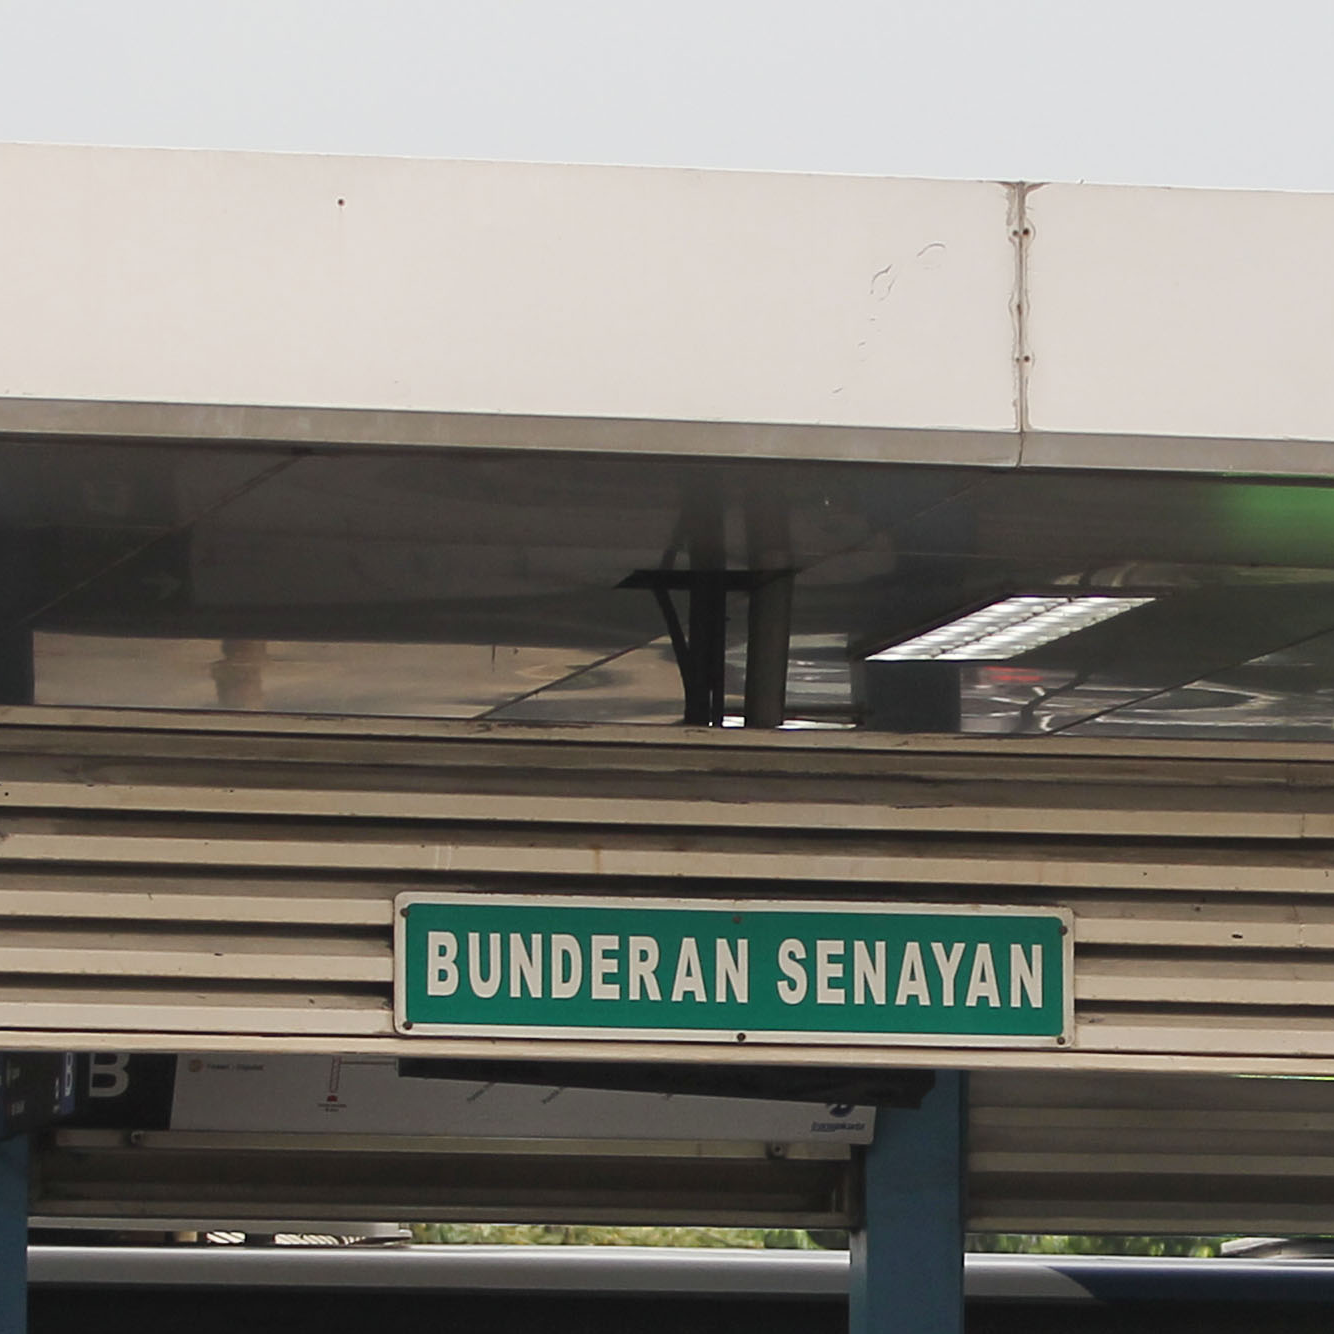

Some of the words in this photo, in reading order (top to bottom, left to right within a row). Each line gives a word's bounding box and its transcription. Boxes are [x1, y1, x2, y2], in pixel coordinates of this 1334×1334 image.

[427, 931, 749, 1002] BUNDERAN
[777, 938, 1043, 1009] SENAYAN
[88, 1052, 130, 1098] B
